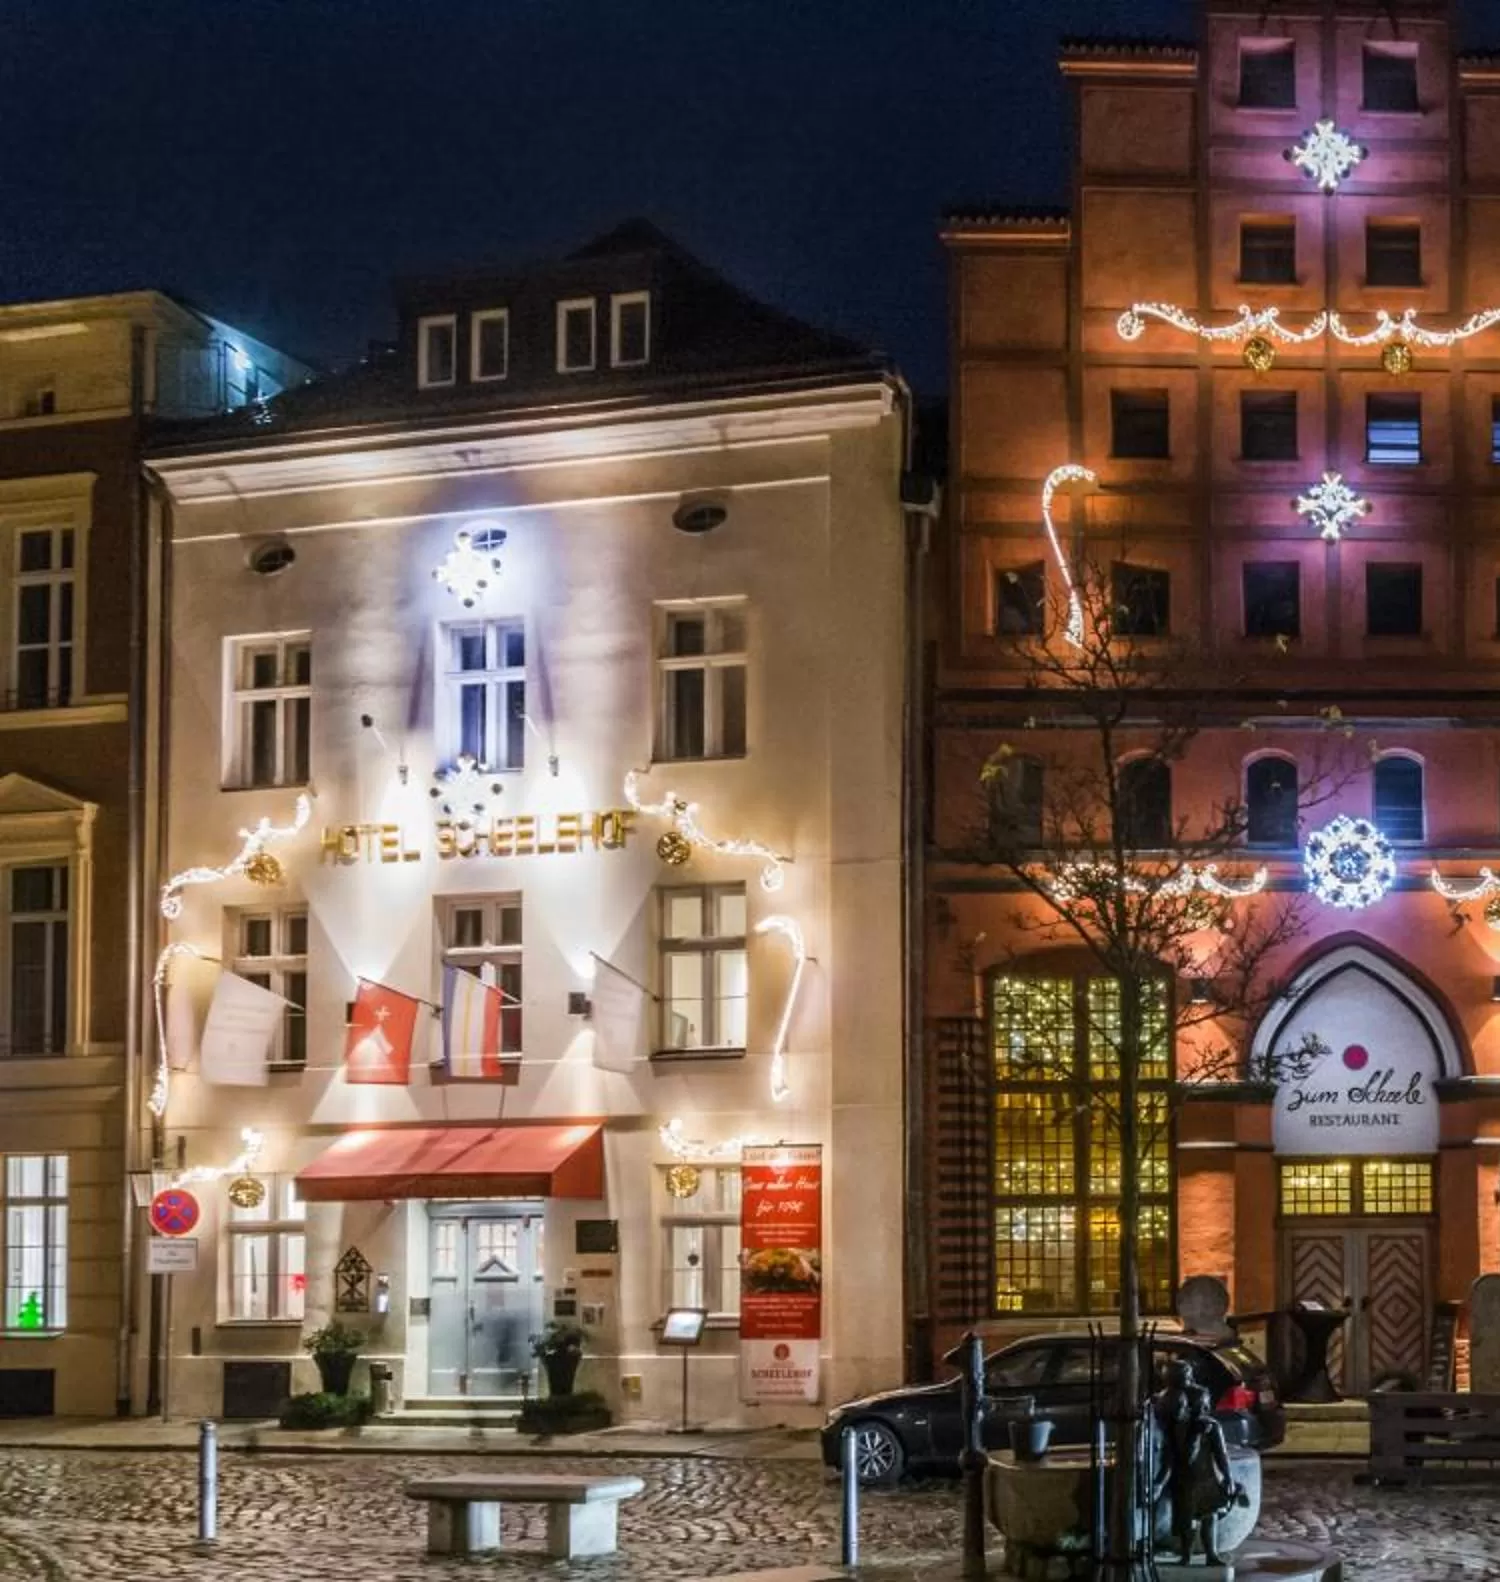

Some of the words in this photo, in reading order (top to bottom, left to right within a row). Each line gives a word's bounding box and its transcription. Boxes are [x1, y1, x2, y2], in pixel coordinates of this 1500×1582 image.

[320, 823, 421, 865] HOTEL
[435, 809, 638, 860] SCHEELEHOF
[1309, 1112, 1401, 1128] RESTAURANT
